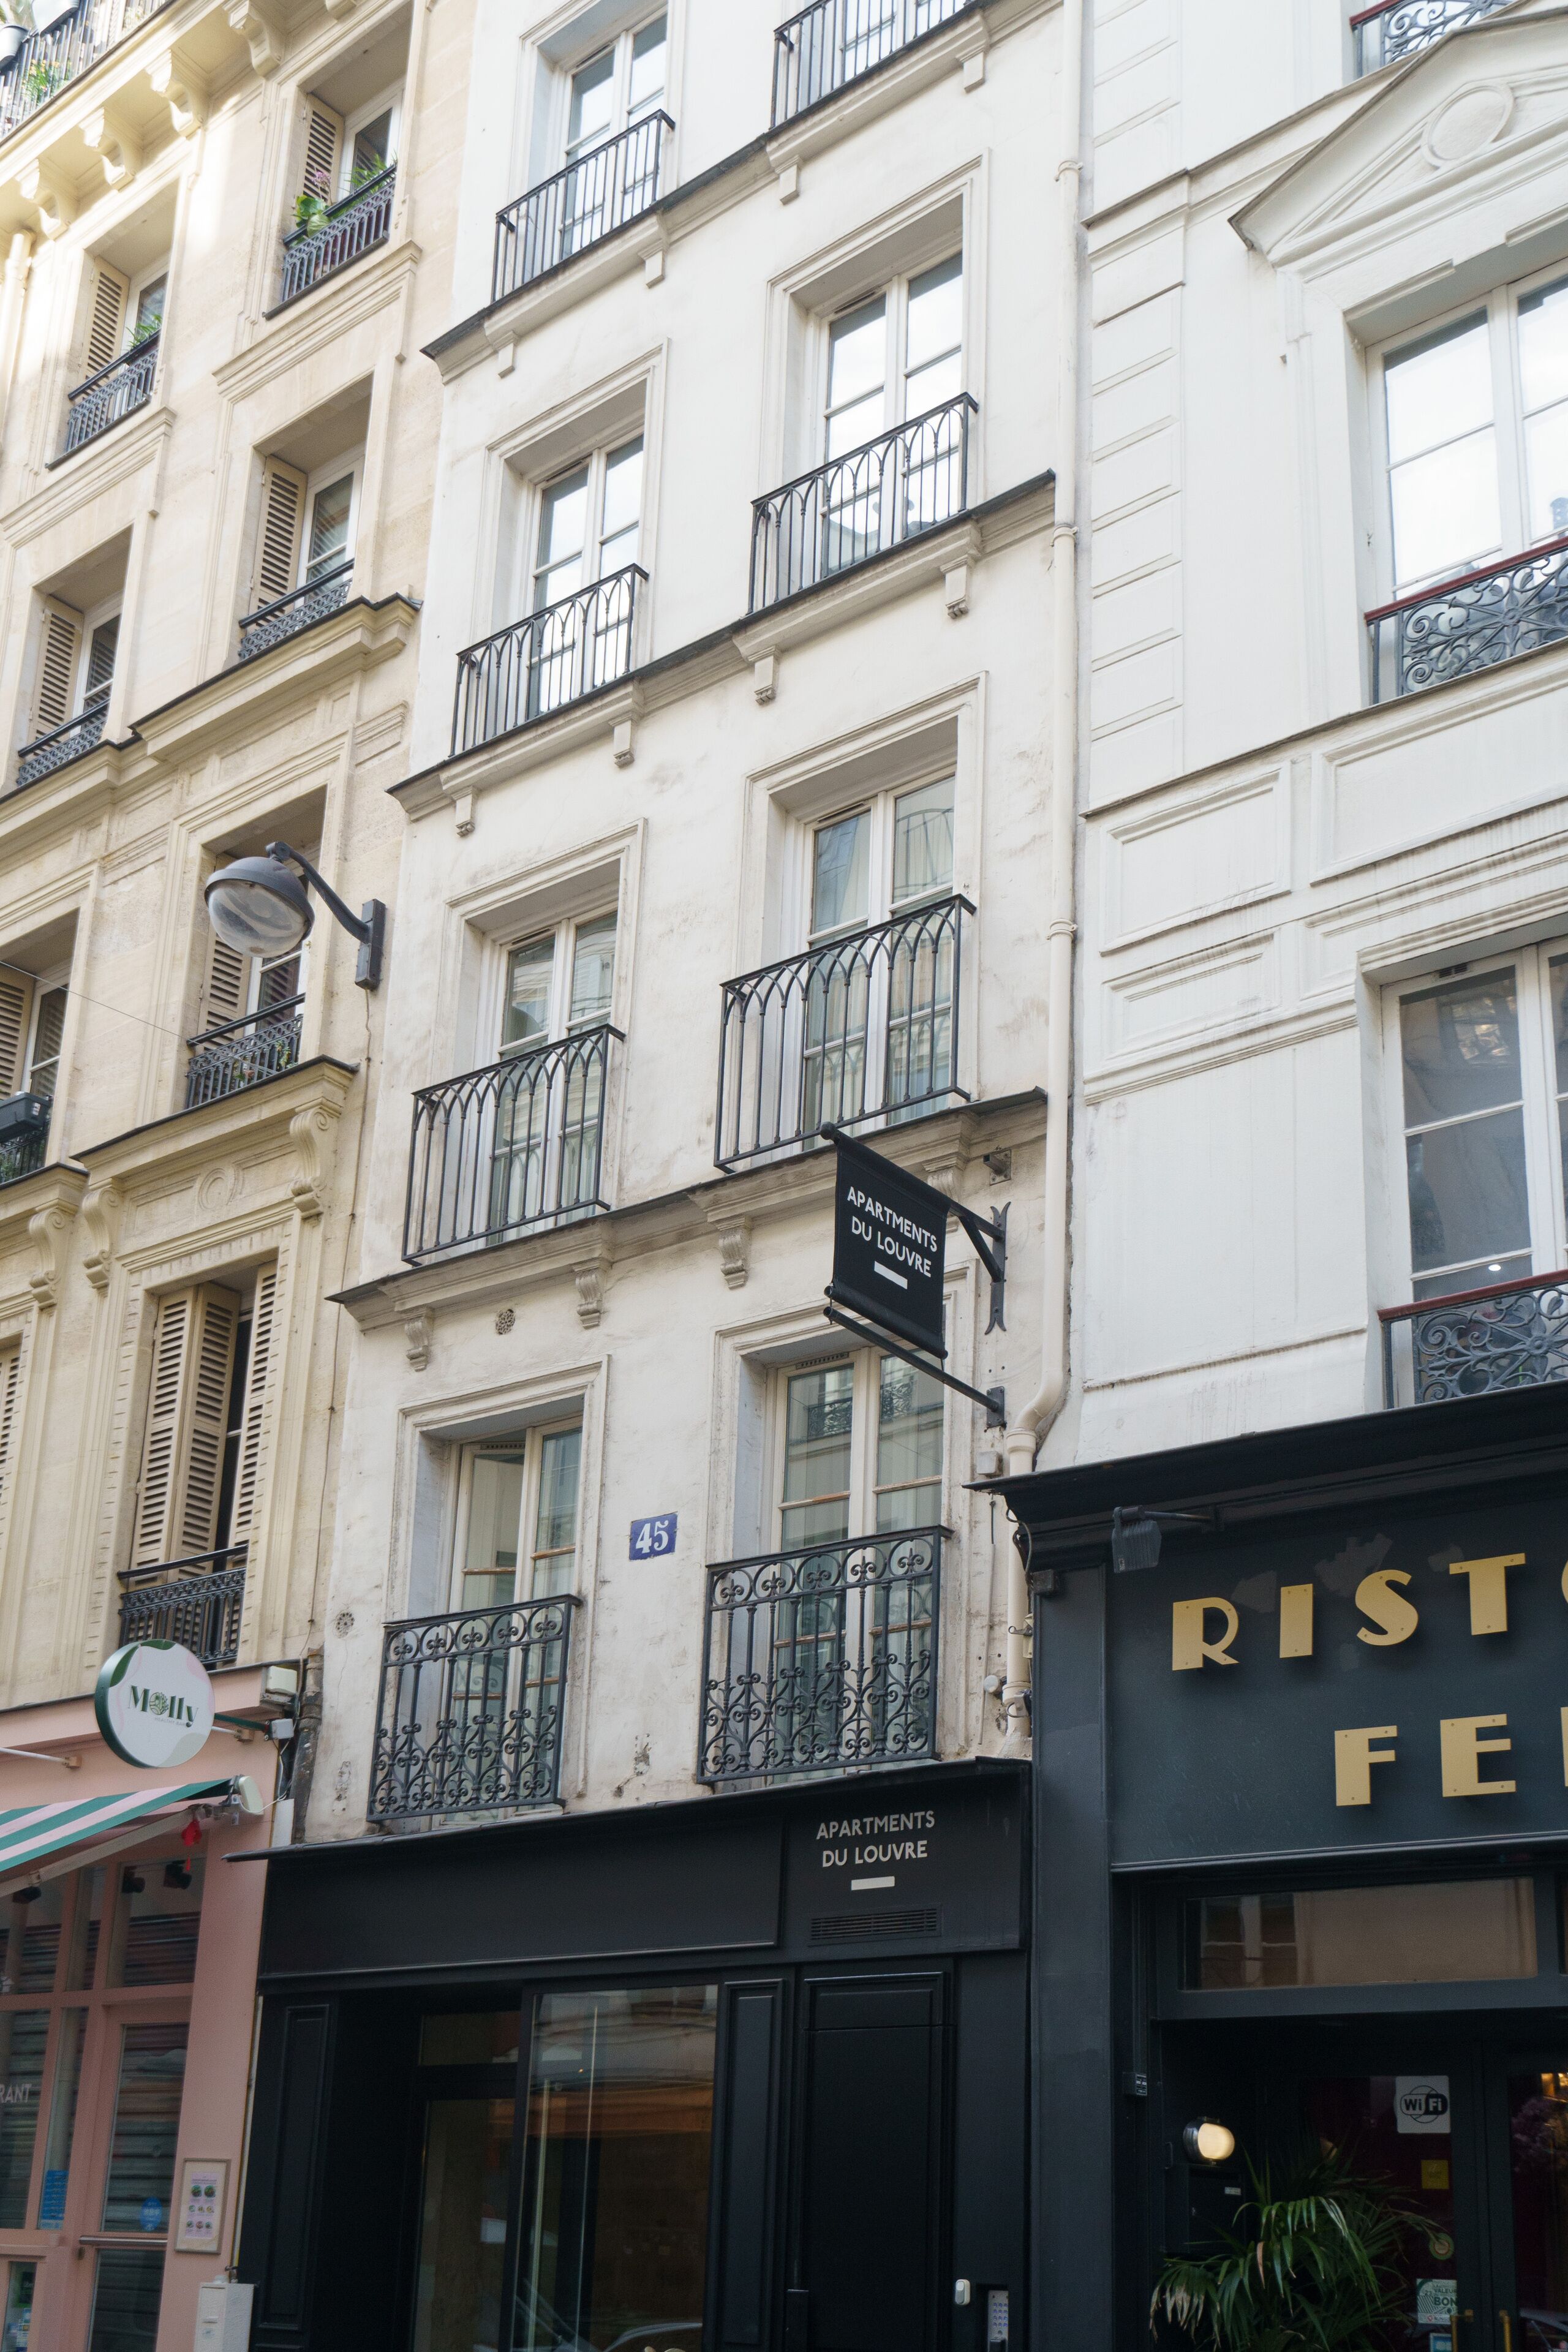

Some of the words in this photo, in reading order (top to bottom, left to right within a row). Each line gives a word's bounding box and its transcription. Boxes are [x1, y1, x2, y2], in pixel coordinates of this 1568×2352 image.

[847, 1186, 937, 1252] APARTMENTS
[851, 1215, 872, 1241] DU
[877, 1231, 932, 1278] LOUVRE
[636, 1520, 669, 1554] 45
[1172, 1553, 1568, 1671] RIST
[1334, 1707, 1568, 1807] FE
[816, 1810, 935, 1840] APARTMENTS
[822, 1848, 848, 1868] DU
[855, 1840, 928, 1864] LOUVRE
